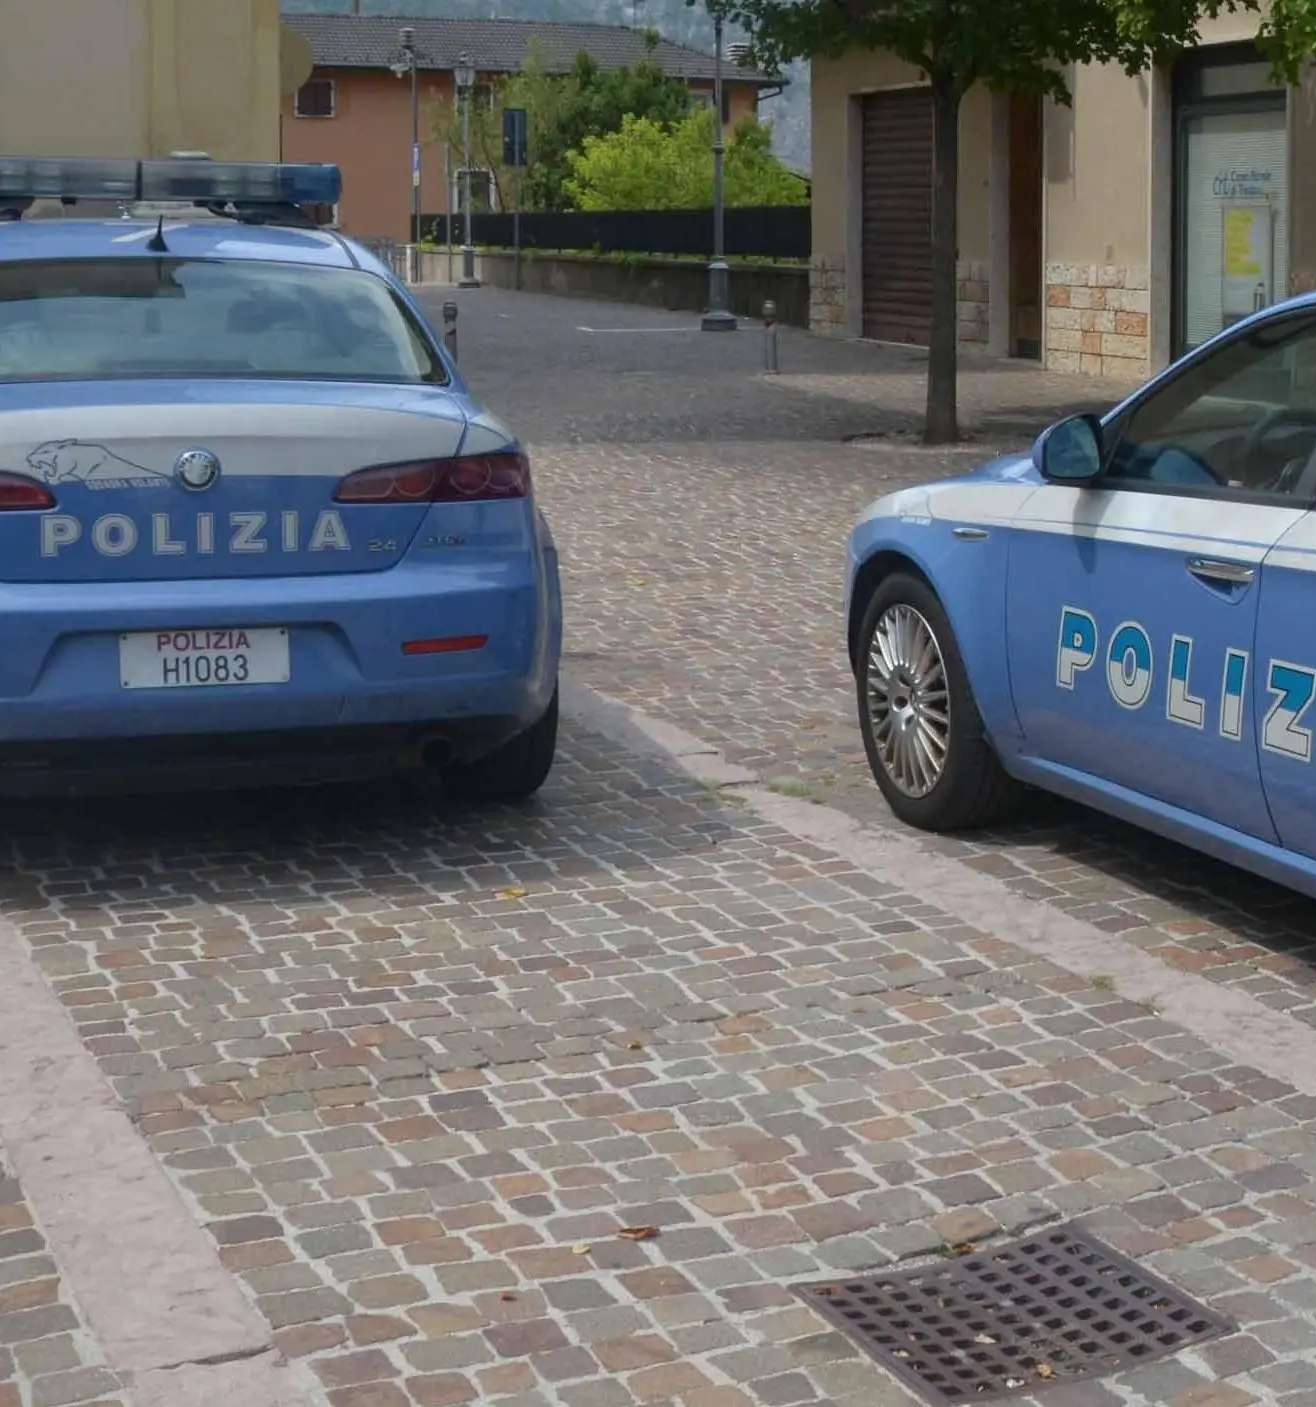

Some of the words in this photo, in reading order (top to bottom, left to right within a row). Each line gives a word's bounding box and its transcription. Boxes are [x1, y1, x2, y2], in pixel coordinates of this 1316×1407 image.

[40, 510, 351, 557] POLIZIA
[156, 630, 251, 652] POLIZIA
[163, 653, 249, 684] H1083
